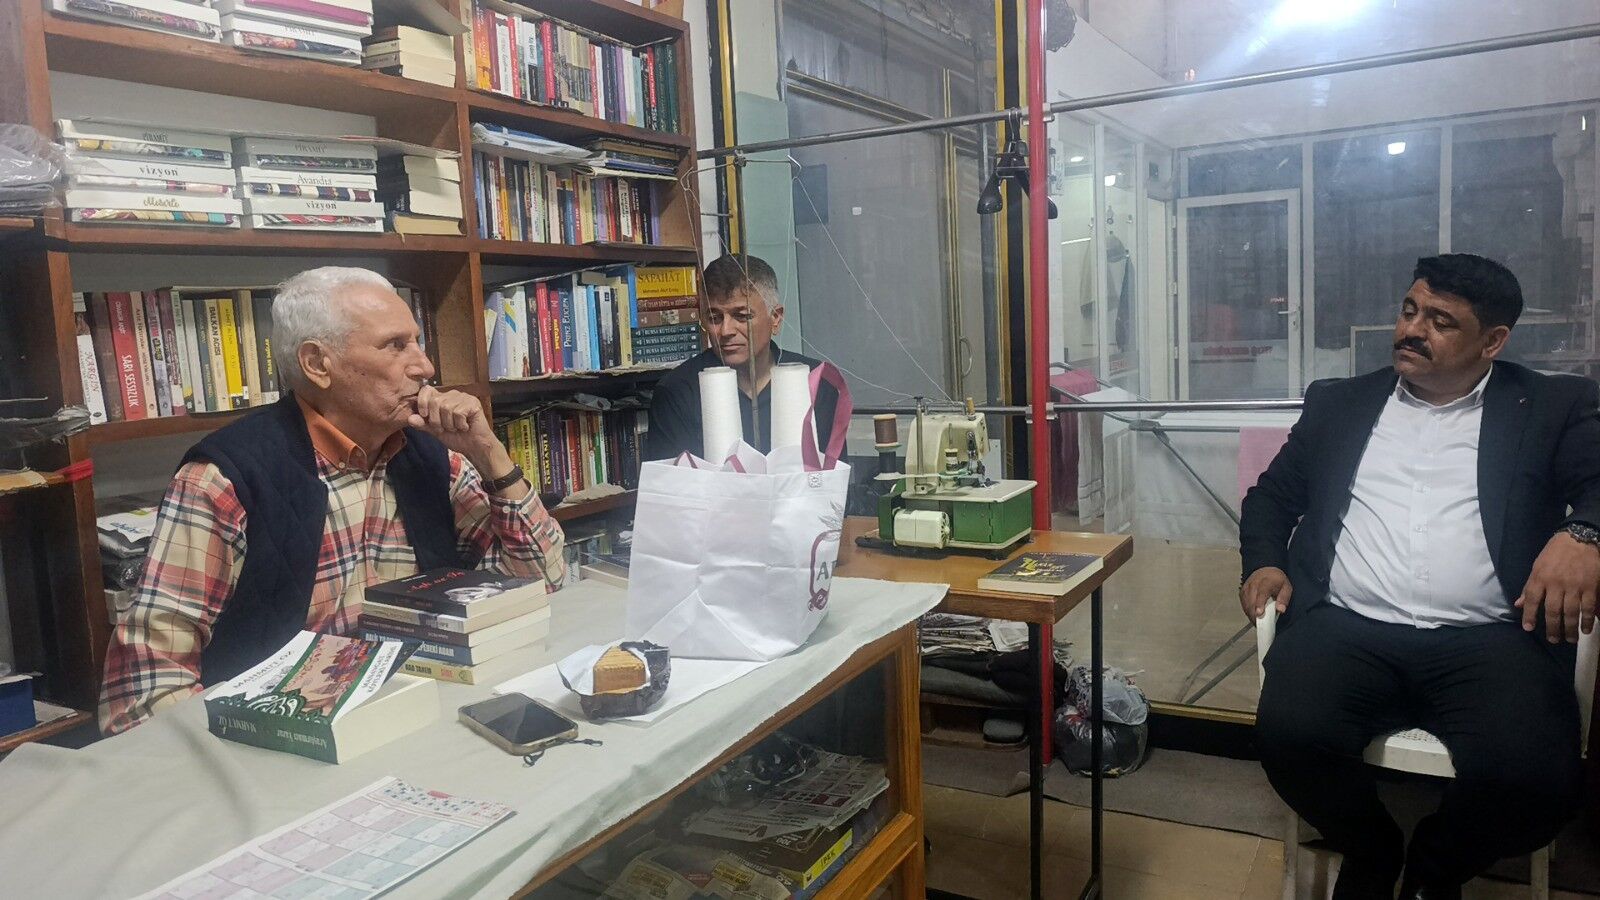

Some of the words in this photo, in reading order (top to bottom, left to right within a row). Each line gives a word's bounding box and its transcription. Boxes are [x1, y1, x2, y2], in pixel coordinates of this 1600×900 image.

[139, 165, 178, 177] vizyon
[306, 201, 337, 211] vizyon
[208, 306, 219, 336] BALKAN
[121, 354, 134, 372] SARI
